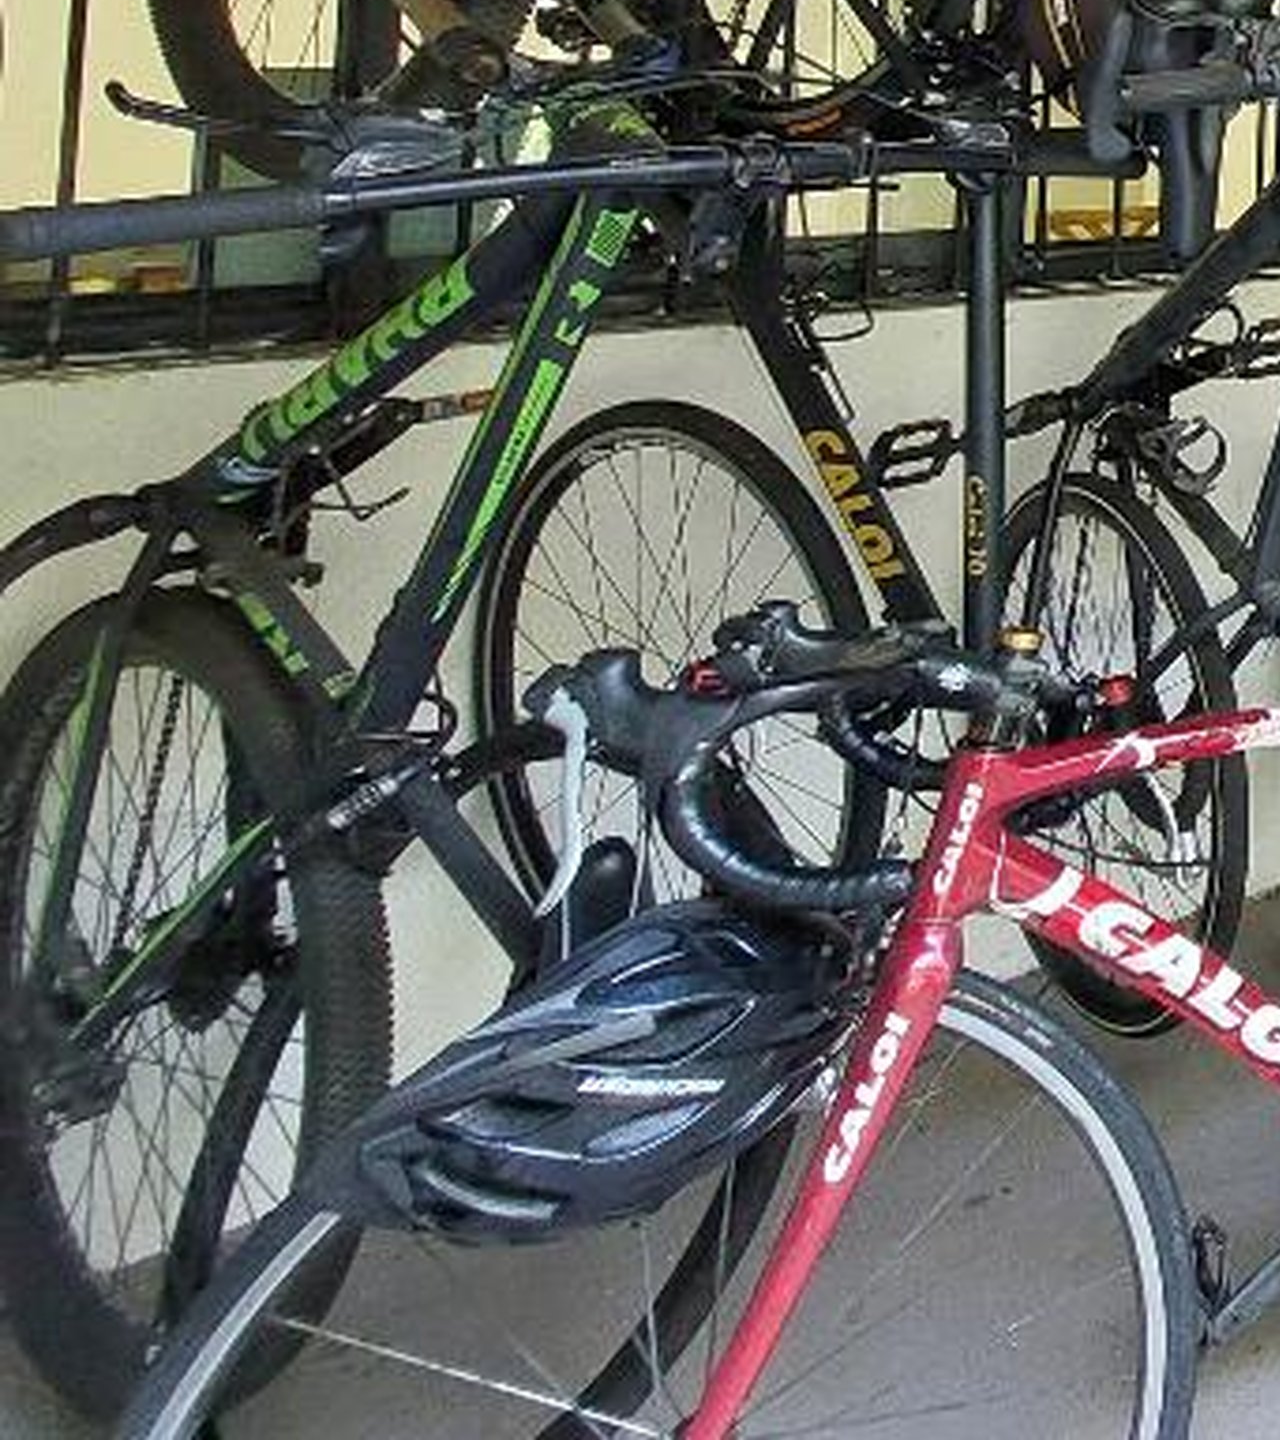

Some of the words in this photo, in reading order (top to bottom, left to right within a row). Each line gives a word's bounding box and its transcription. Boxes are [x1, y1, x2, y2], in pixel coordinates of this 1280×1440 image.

[803, 428, 907, 586] CALOI
[932, 783, 984, 895] CALOI
[822, 1013, 912, 1185] CALOI
